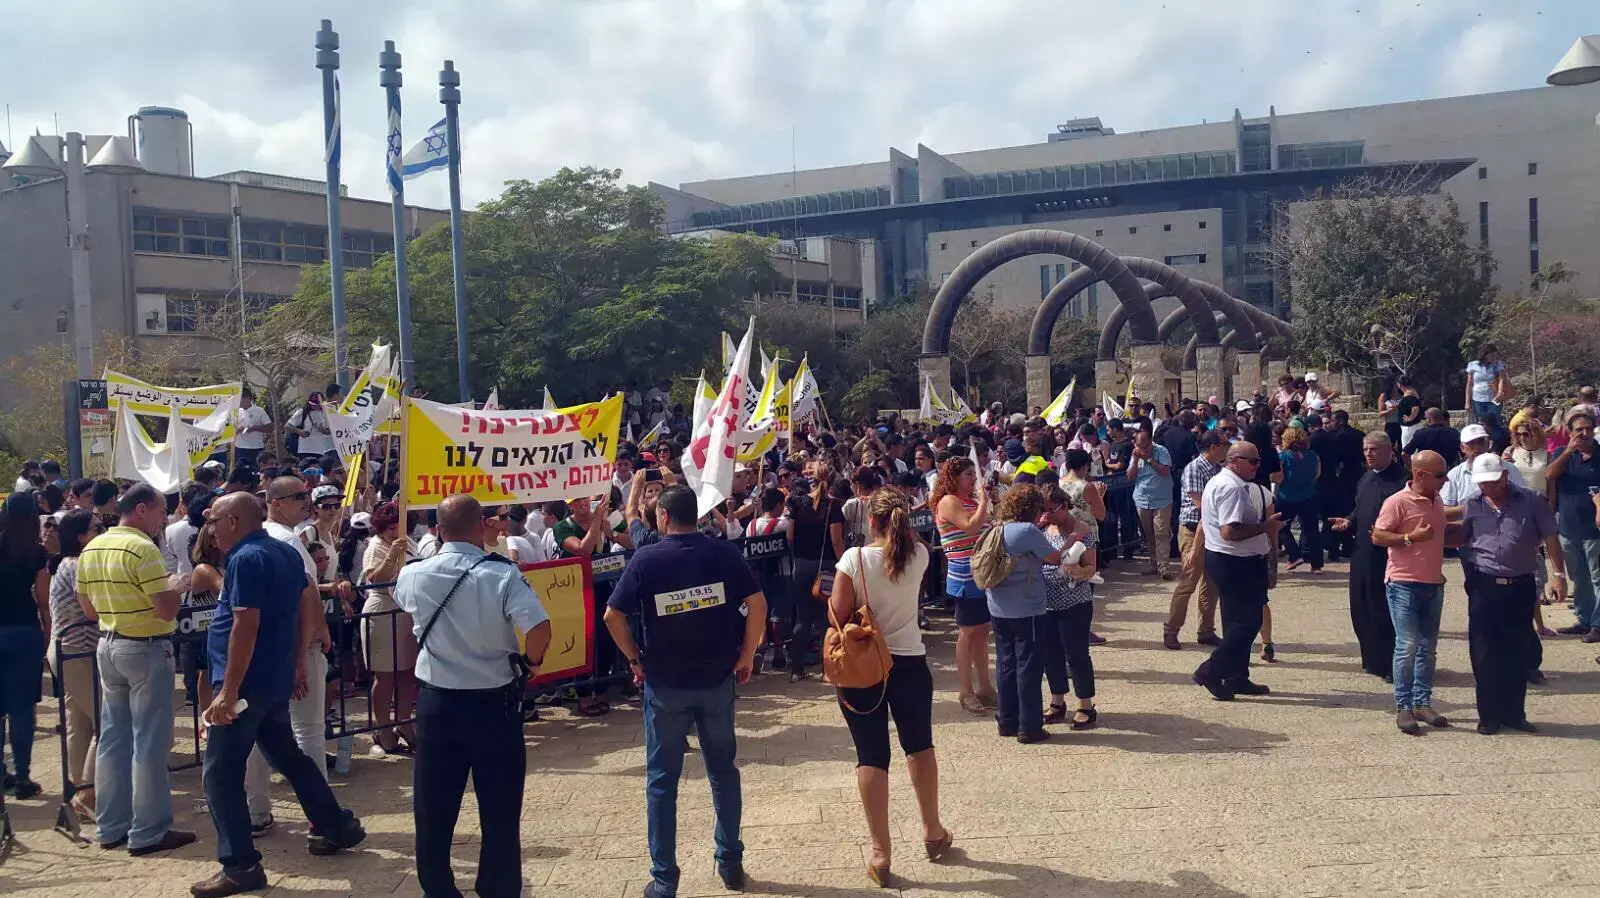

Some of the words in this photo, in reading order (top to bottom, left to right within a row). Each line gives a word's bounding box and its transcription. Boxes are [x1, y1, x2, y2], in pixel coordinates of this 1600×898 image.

[134, 389, 162, 402] الوضع
[461, 407, 600, 436] לצערינו!
[444, 441, 484, 468] לנו
[491, 440, 574, 468] קוראים
[581, 432, 609, 459] לא
[416, 474, 495, 497] ויעקוב
[500, 469, 557, 496] יצחק
[750, 539, 785, 555] POLICE
[668, 591, 687, 601] עבר
[689, 586, 713, 597] 1.9.15
